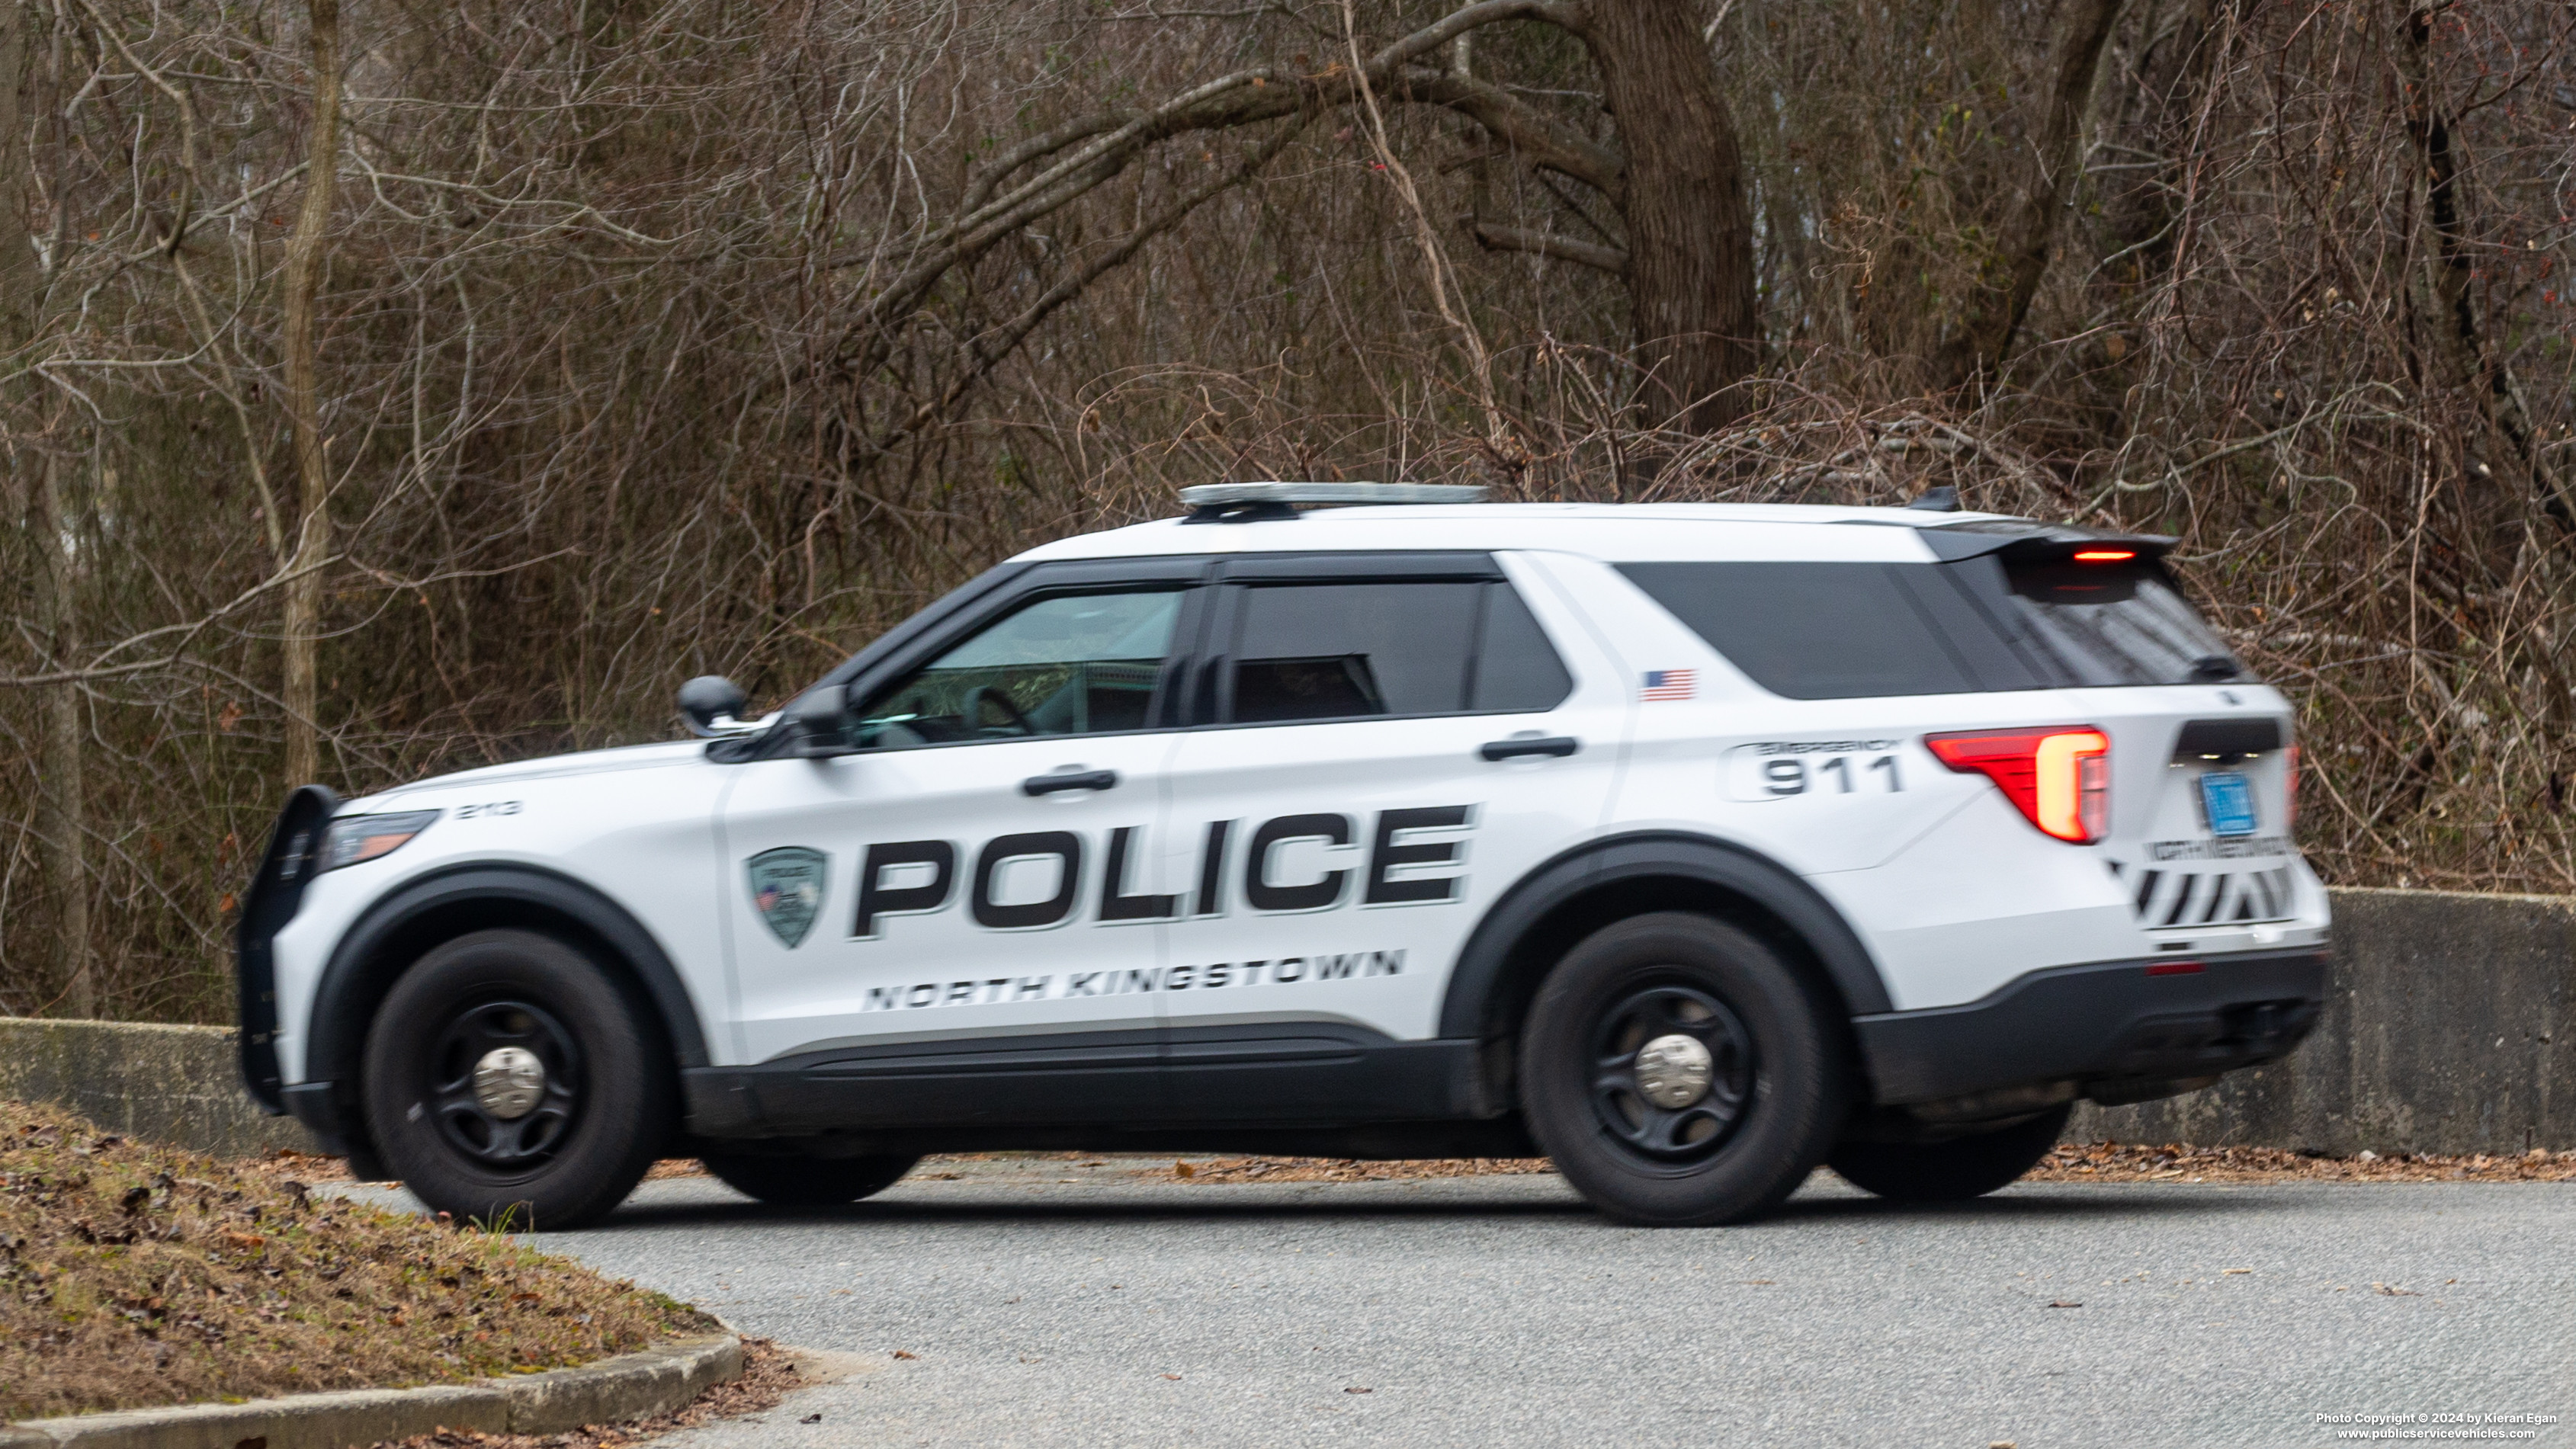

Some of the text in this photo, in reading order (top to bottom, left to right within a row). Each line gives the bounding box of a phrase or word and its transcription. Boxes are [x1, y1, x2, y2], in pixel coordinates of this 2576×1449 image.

[1761, 755, 1906, 795] 911
[848, 803, 1477, 940] POLICE
[861, 949, 1407, 1012] NORTH KINGSTOWN
